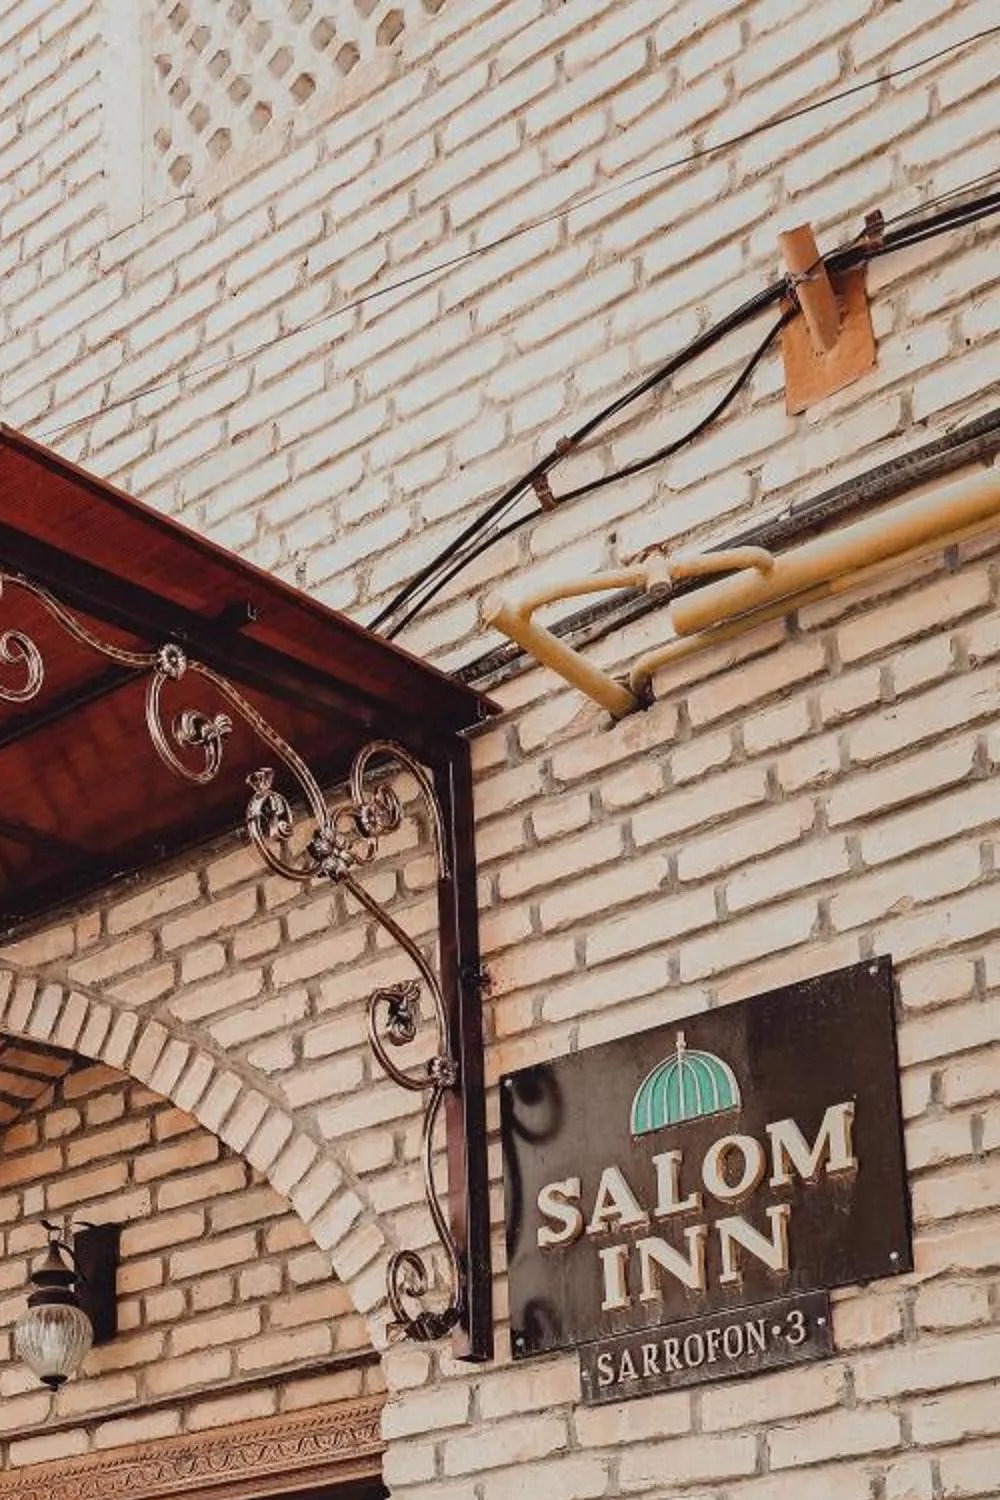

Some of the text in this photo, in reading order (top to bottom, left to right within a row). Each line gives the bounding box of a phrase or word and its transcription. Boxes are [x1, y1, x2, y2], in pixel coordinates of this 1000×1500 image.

[537, 1101, 859, 1248] SALOM
[599, 1203, 792, 1311] INN
[597, 1319, 767, 1387] SARROFON
